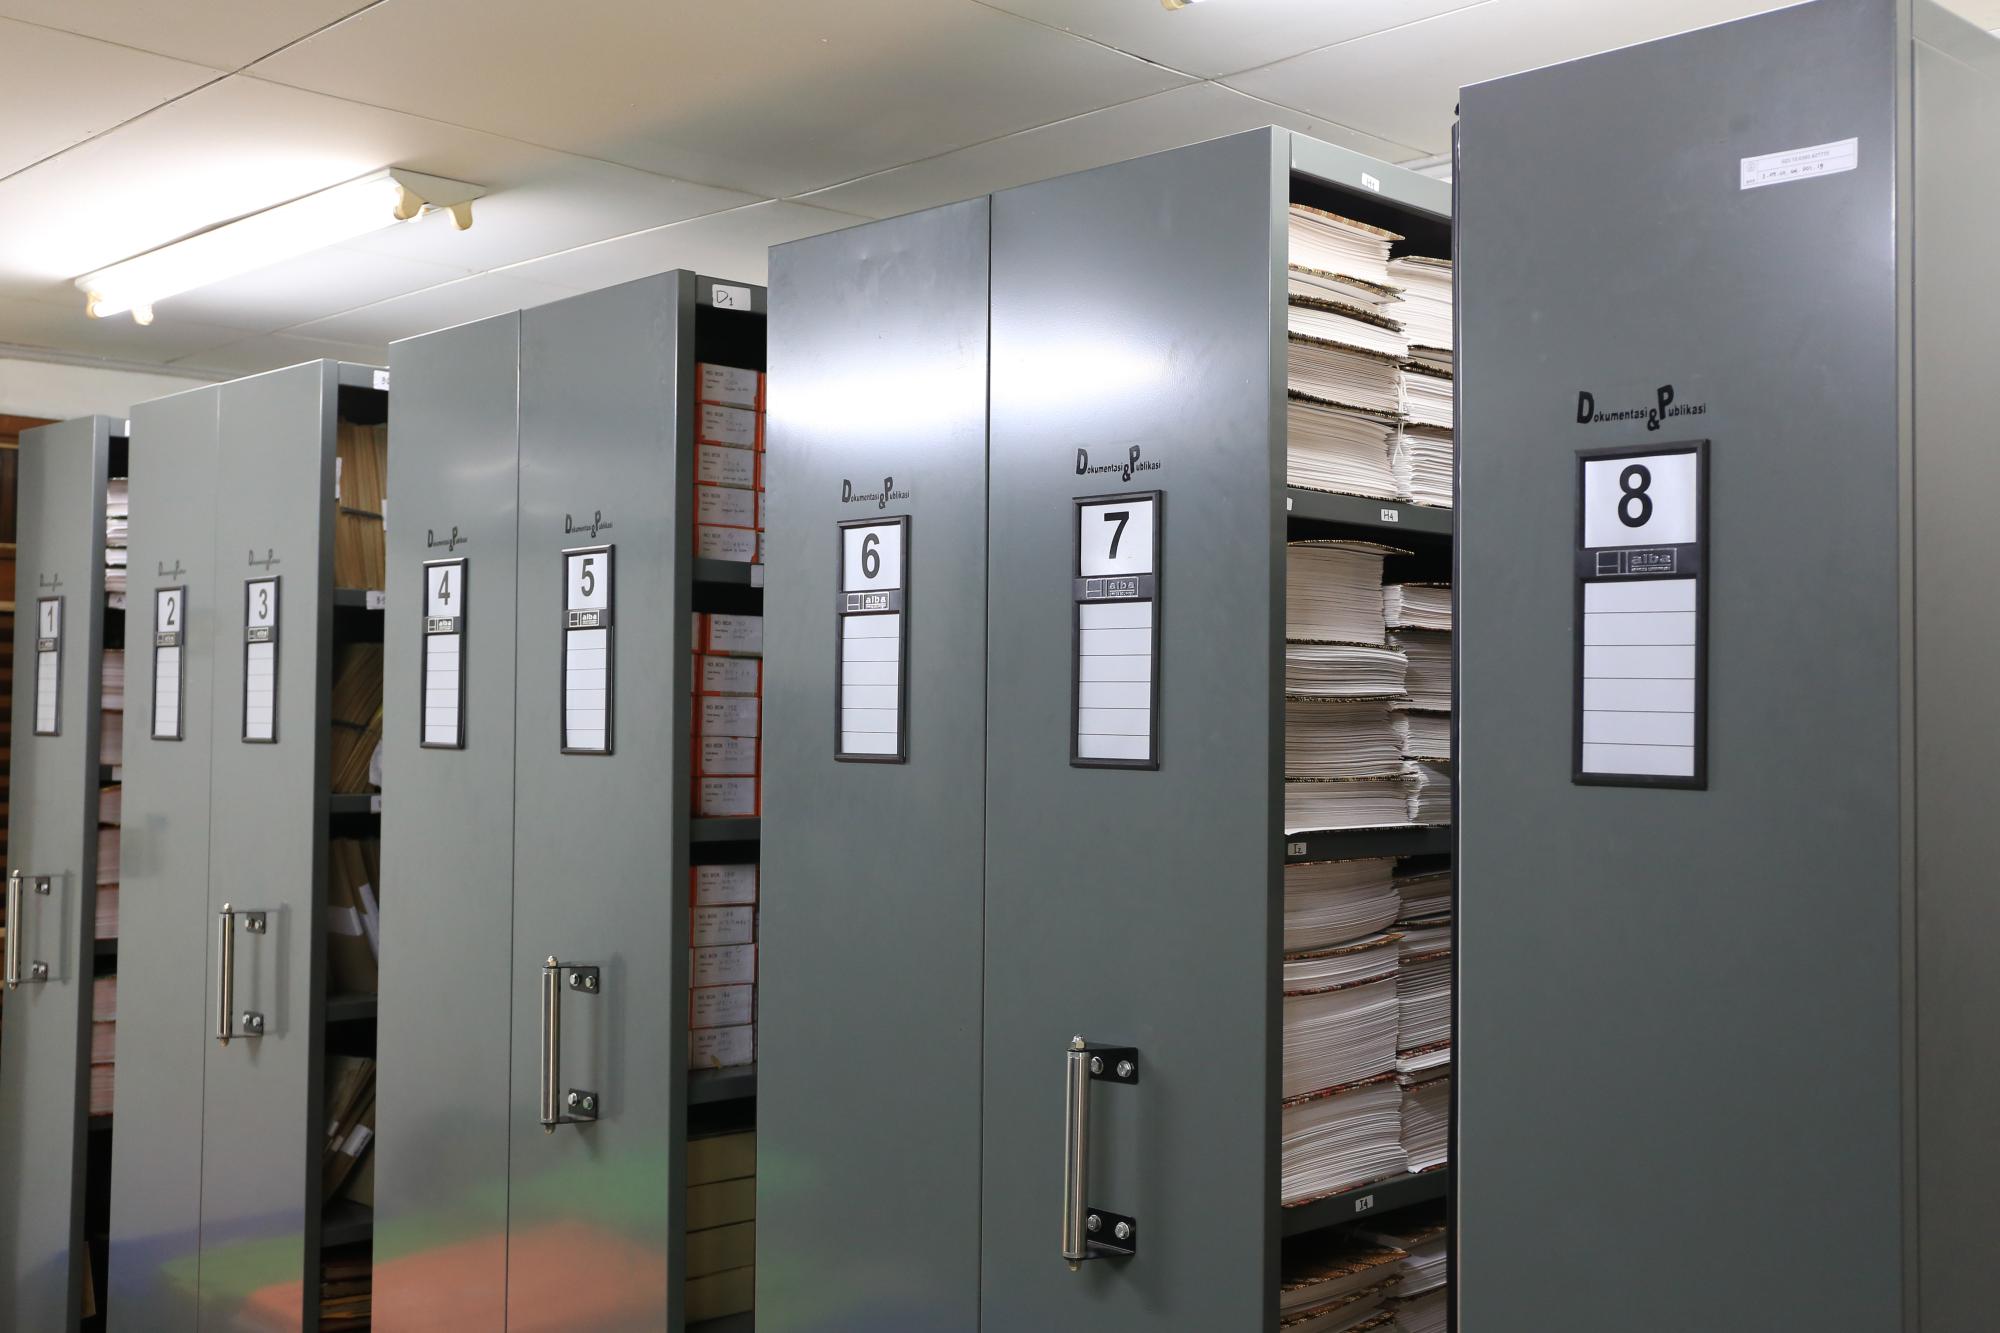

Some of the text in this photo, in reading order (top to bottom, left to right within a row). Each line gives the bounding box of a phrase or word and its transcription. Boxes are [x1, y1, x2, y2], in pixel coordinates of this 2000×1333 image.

[1576, 390, 1648, 425] Dokumentasi
[1656, 384, 1707, 421] Publikasi
[1075, 447, 1123, 475] Dokumentasi
[1128, 444, 1161, 475] Publikasi
[1617, 463, 1653, 528] 8
[1103, 511, 1130, 560] 7
[861, 532, 881, 579] 6
[437, 569, 451, 606] 4
[581, 558, 595, 597] 5
[47, 605, 54, 633] 1
[166, 596, 176, 626] 2
[258, 588, 268, 620] 3
